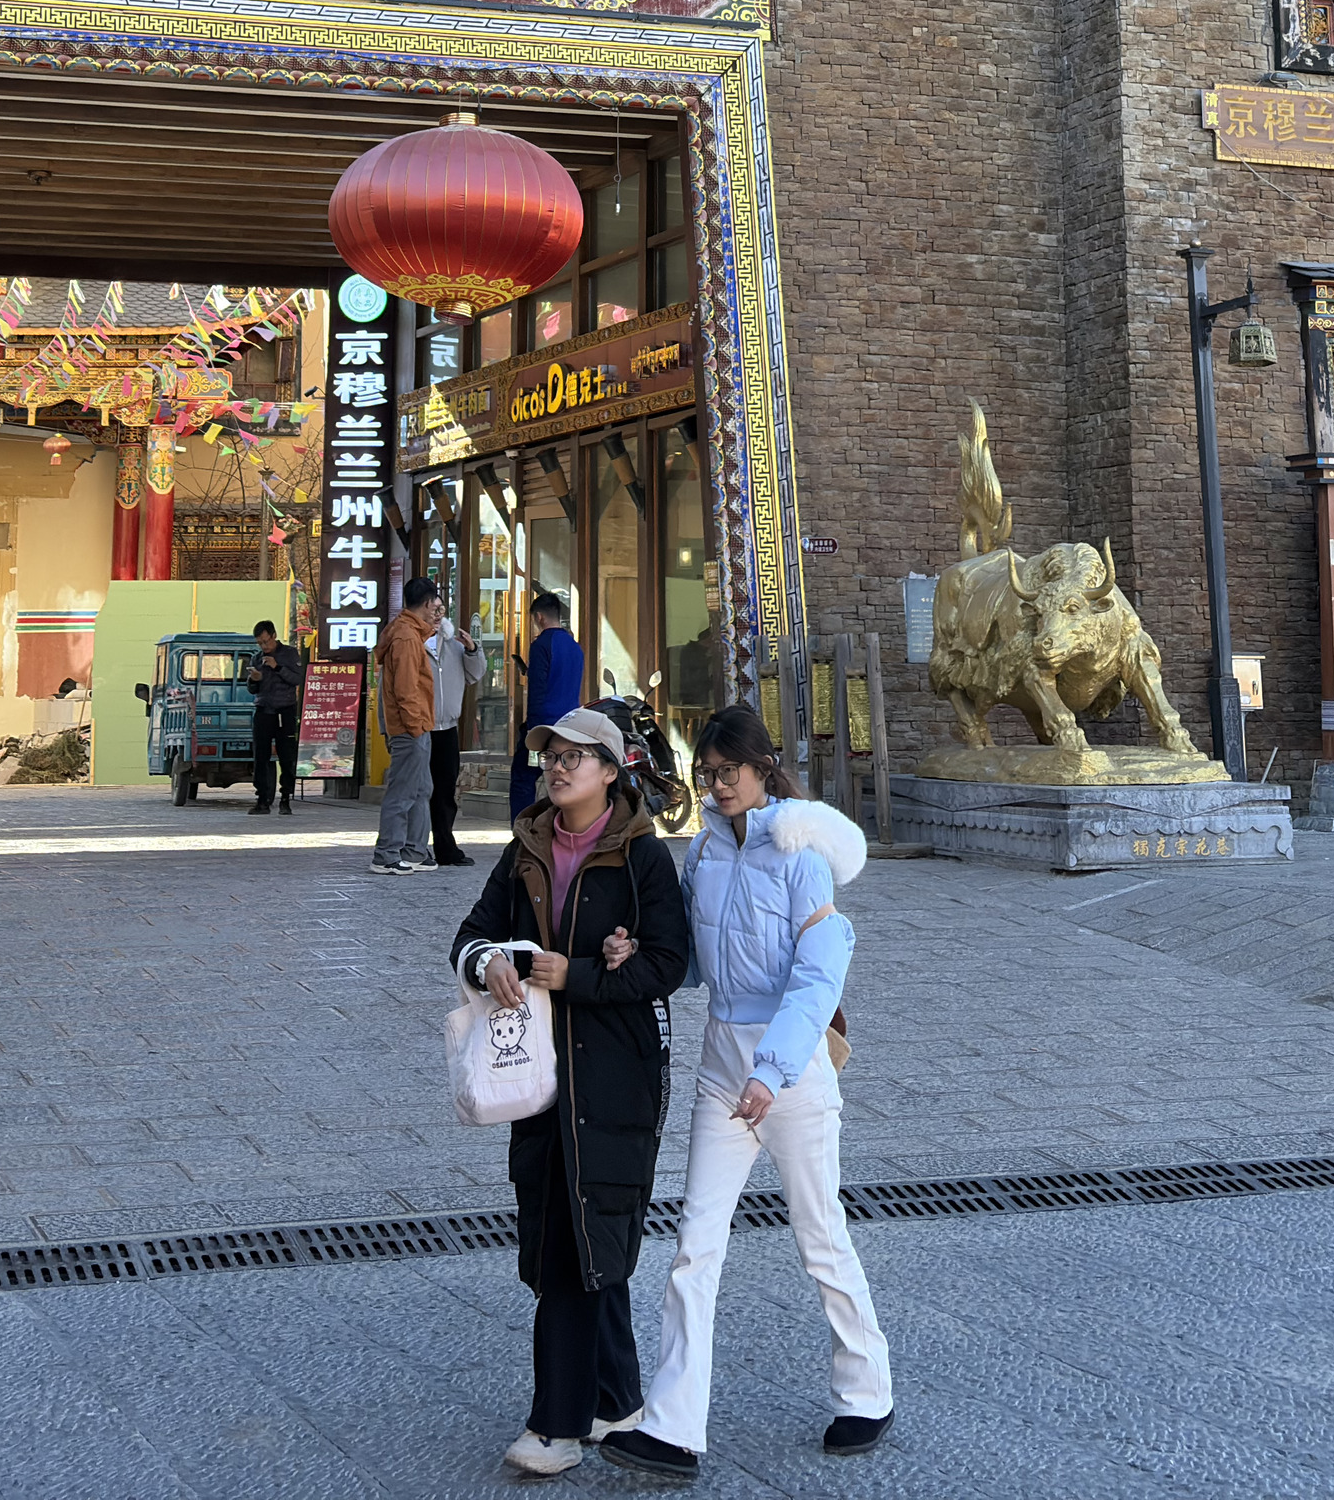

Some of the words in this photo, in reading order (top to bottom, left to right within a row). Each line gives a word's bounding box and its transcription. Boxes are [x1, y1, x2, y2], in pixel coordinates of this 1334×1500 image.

[1204, 92, 1219, 126] 清真
[565, 365, 607, 408] 德克士
[326, 329, 389, 651] 京穆兰兰州牛肉面
[492, 1060, 513, 1069] OSAMU
